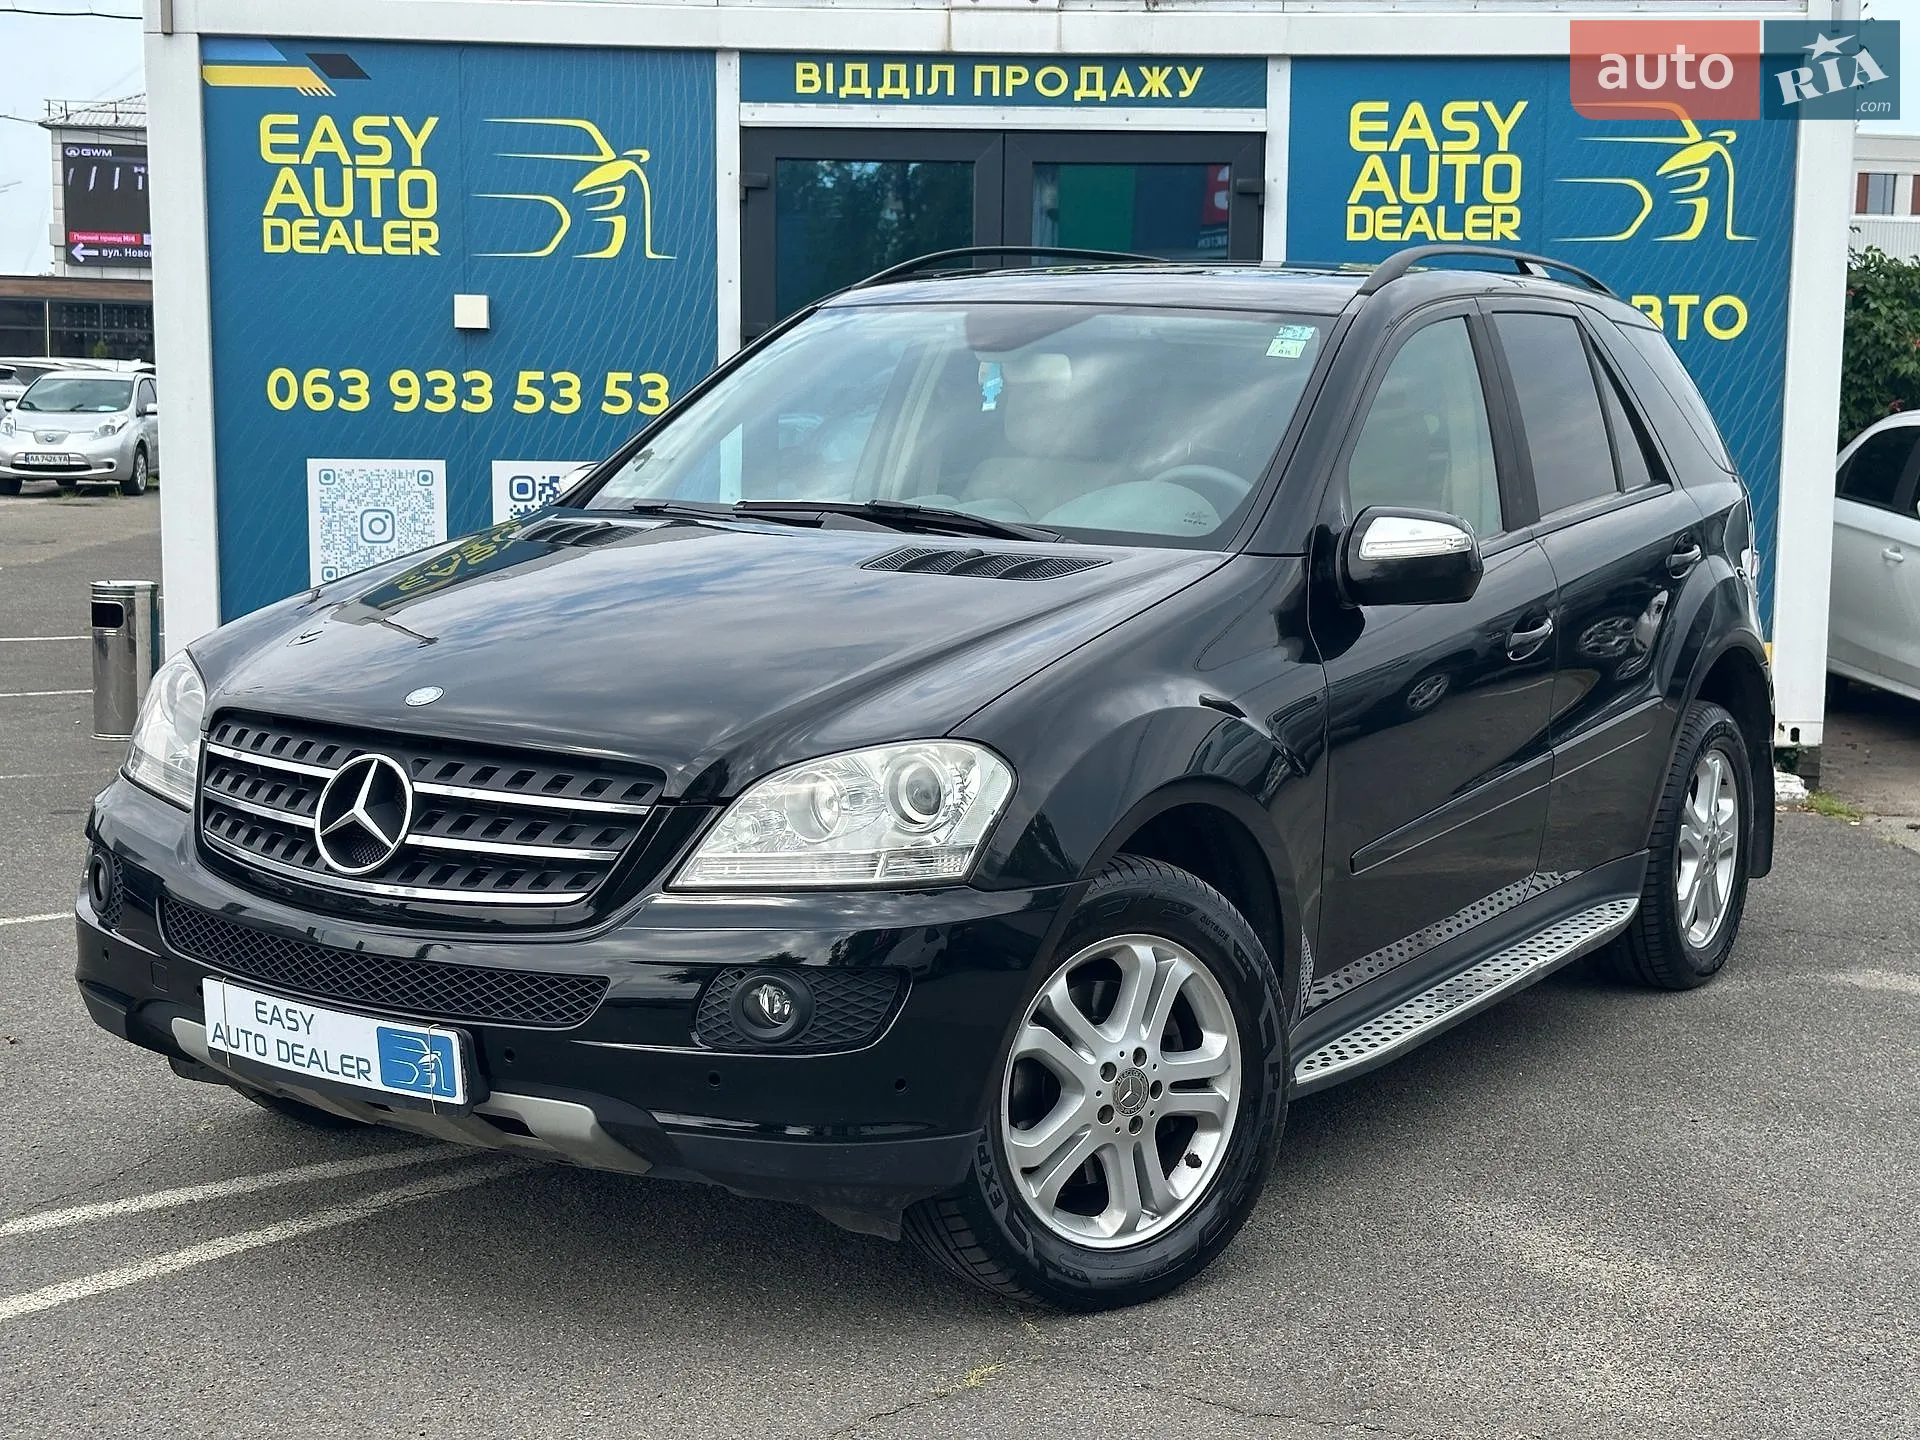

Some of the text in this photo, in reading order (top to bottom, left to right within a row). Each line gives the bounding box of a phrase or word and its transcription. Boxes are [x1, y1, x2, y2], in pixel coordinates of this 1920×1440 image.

[795, 62, 1205, 101] ВІДДІЛ ПРОДАЖУ
[260, 114, 439, 166] EASY
[1349, 101, 1528, 152] EASY
[81, 148, 112, 157] GWM
[263, 167, 438, 218] AUTO
[1348, 154, 1522, 204] AUTO
[263, 218, 441, 256] DEALER
[1346, 206, 1521, 241] DEALER
[102, 248, 122, 258] вул.
[267, 367, 670, 416] 063 933 53 53
[255, 1000, 315, 1036] EASY
[212, 1022, 372, 1082] AUTO DEALER
